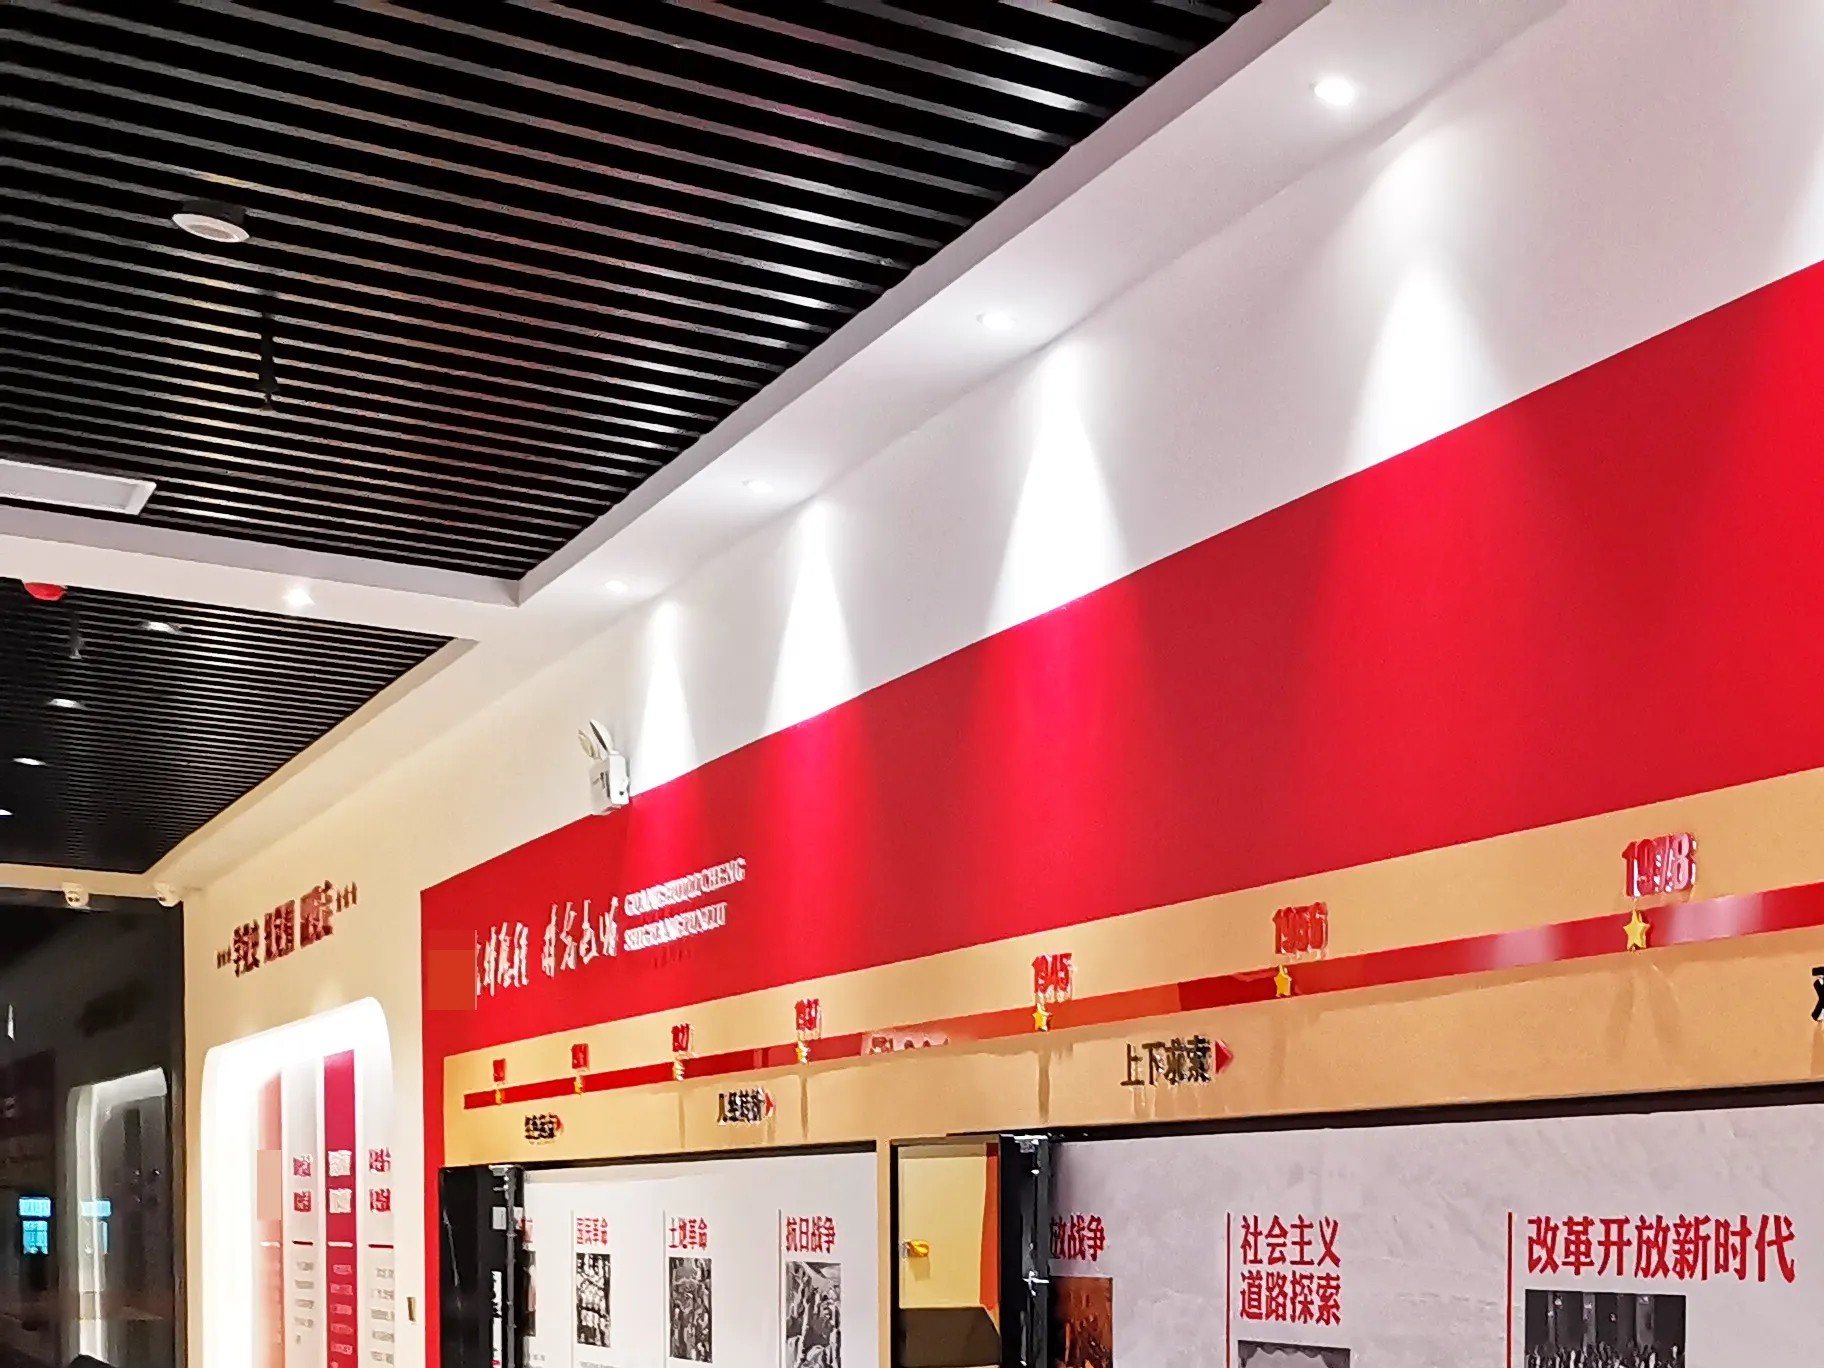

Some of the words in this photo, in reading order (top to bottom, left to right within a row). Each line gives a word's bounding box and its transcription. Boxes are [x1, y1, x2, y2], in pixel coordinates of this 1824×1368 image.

[1032, 953, 1072, 994] 1945
[786, 1215, 835, 1253] 抗日战争
[1050, 1215, 1105, 1261] 放战争
[1240, 1215, 1341, 1268] 社会主义
[1526, 1214, 1796, 1284] 改革开放新时代
[1240, 1272, 1341, 1325] 道路探索
